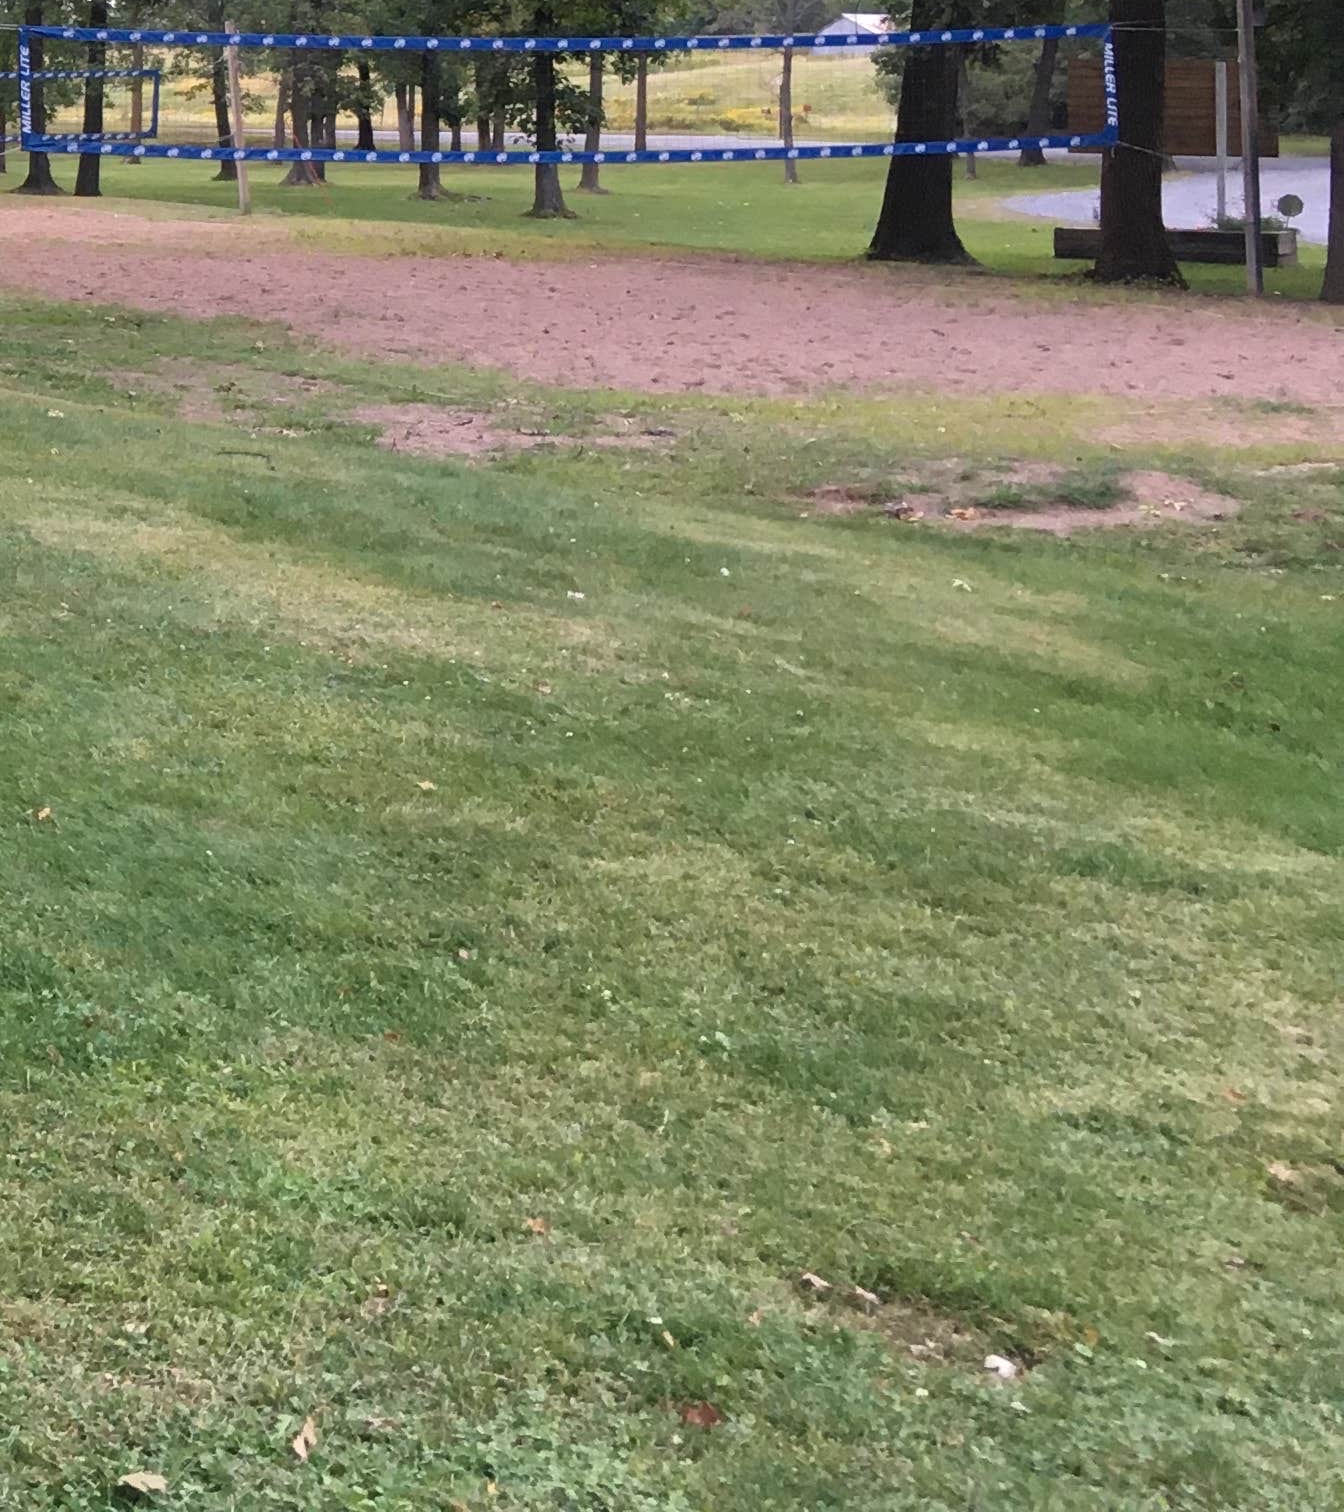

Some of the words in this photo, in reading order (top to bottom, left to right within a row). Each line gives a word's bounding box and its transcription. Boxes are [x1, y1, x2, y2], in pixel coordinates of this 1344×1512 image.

[19, 45, 31, 76] LITE
[1103, 42, 1117, 94] MILLER
[19, 80, 32, 134] MILLER
[1106, 96, 1119, 127] LITE
